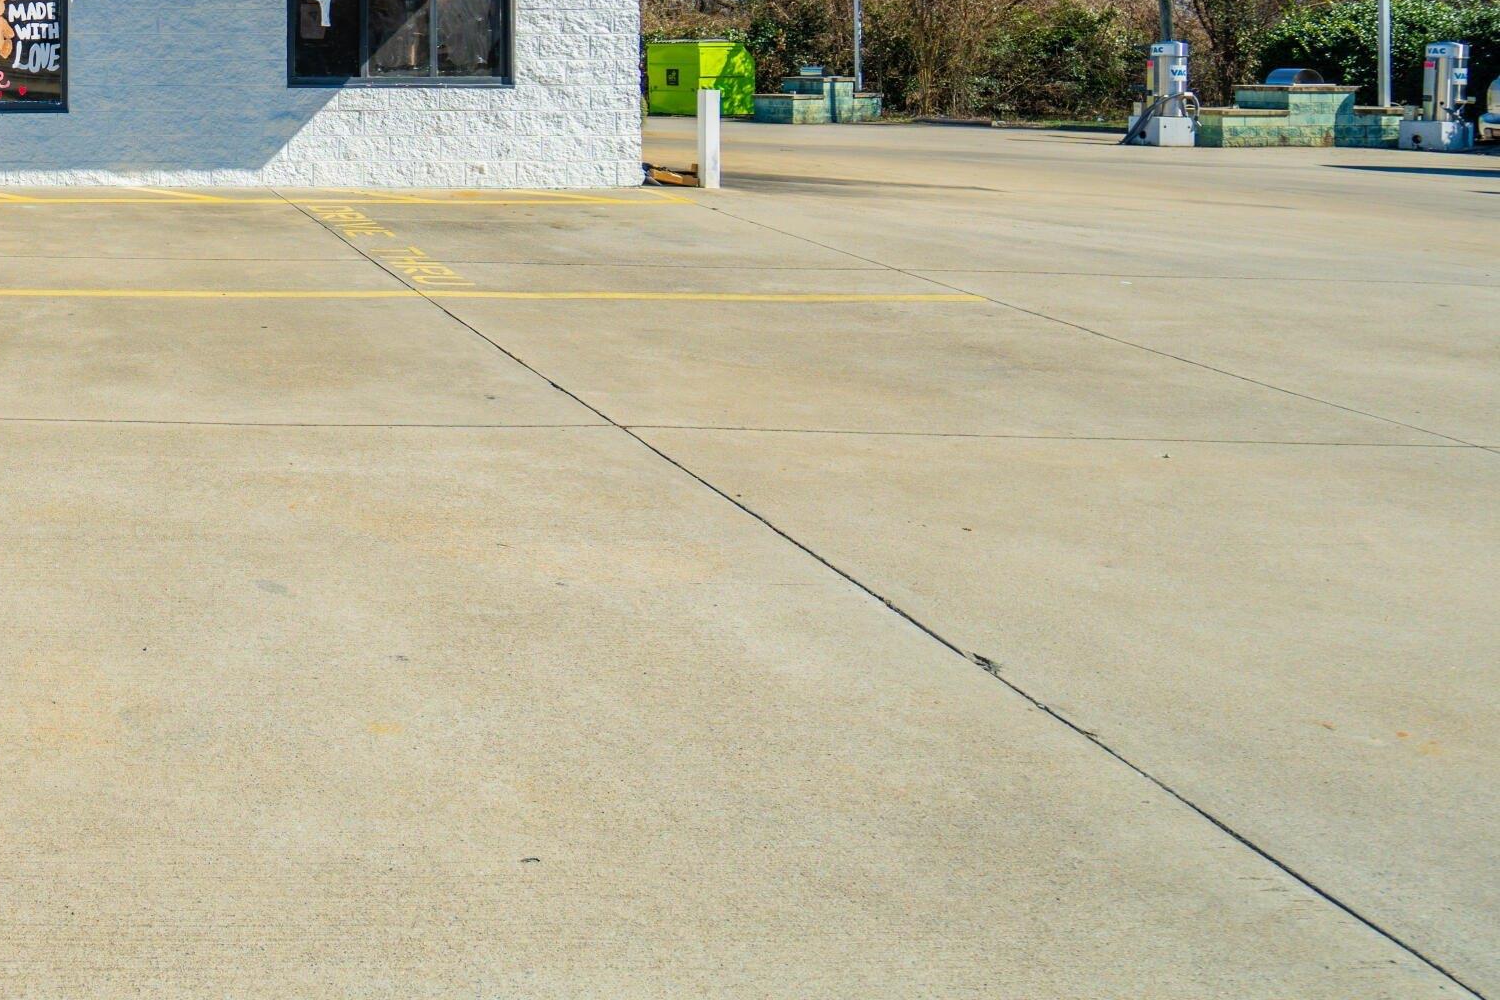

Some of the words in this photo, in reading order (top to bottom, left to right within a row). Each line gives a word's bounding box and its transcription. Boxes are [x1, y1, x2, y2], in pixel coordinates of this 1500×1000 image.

[7, 1, 56, 23] MADE
[13, 21, 60, 41] WITH
[11, 40, 61, 74] LOVE
[307, 205, 396, 238] DRIVE
[370, 245, 476, 286] THRU
